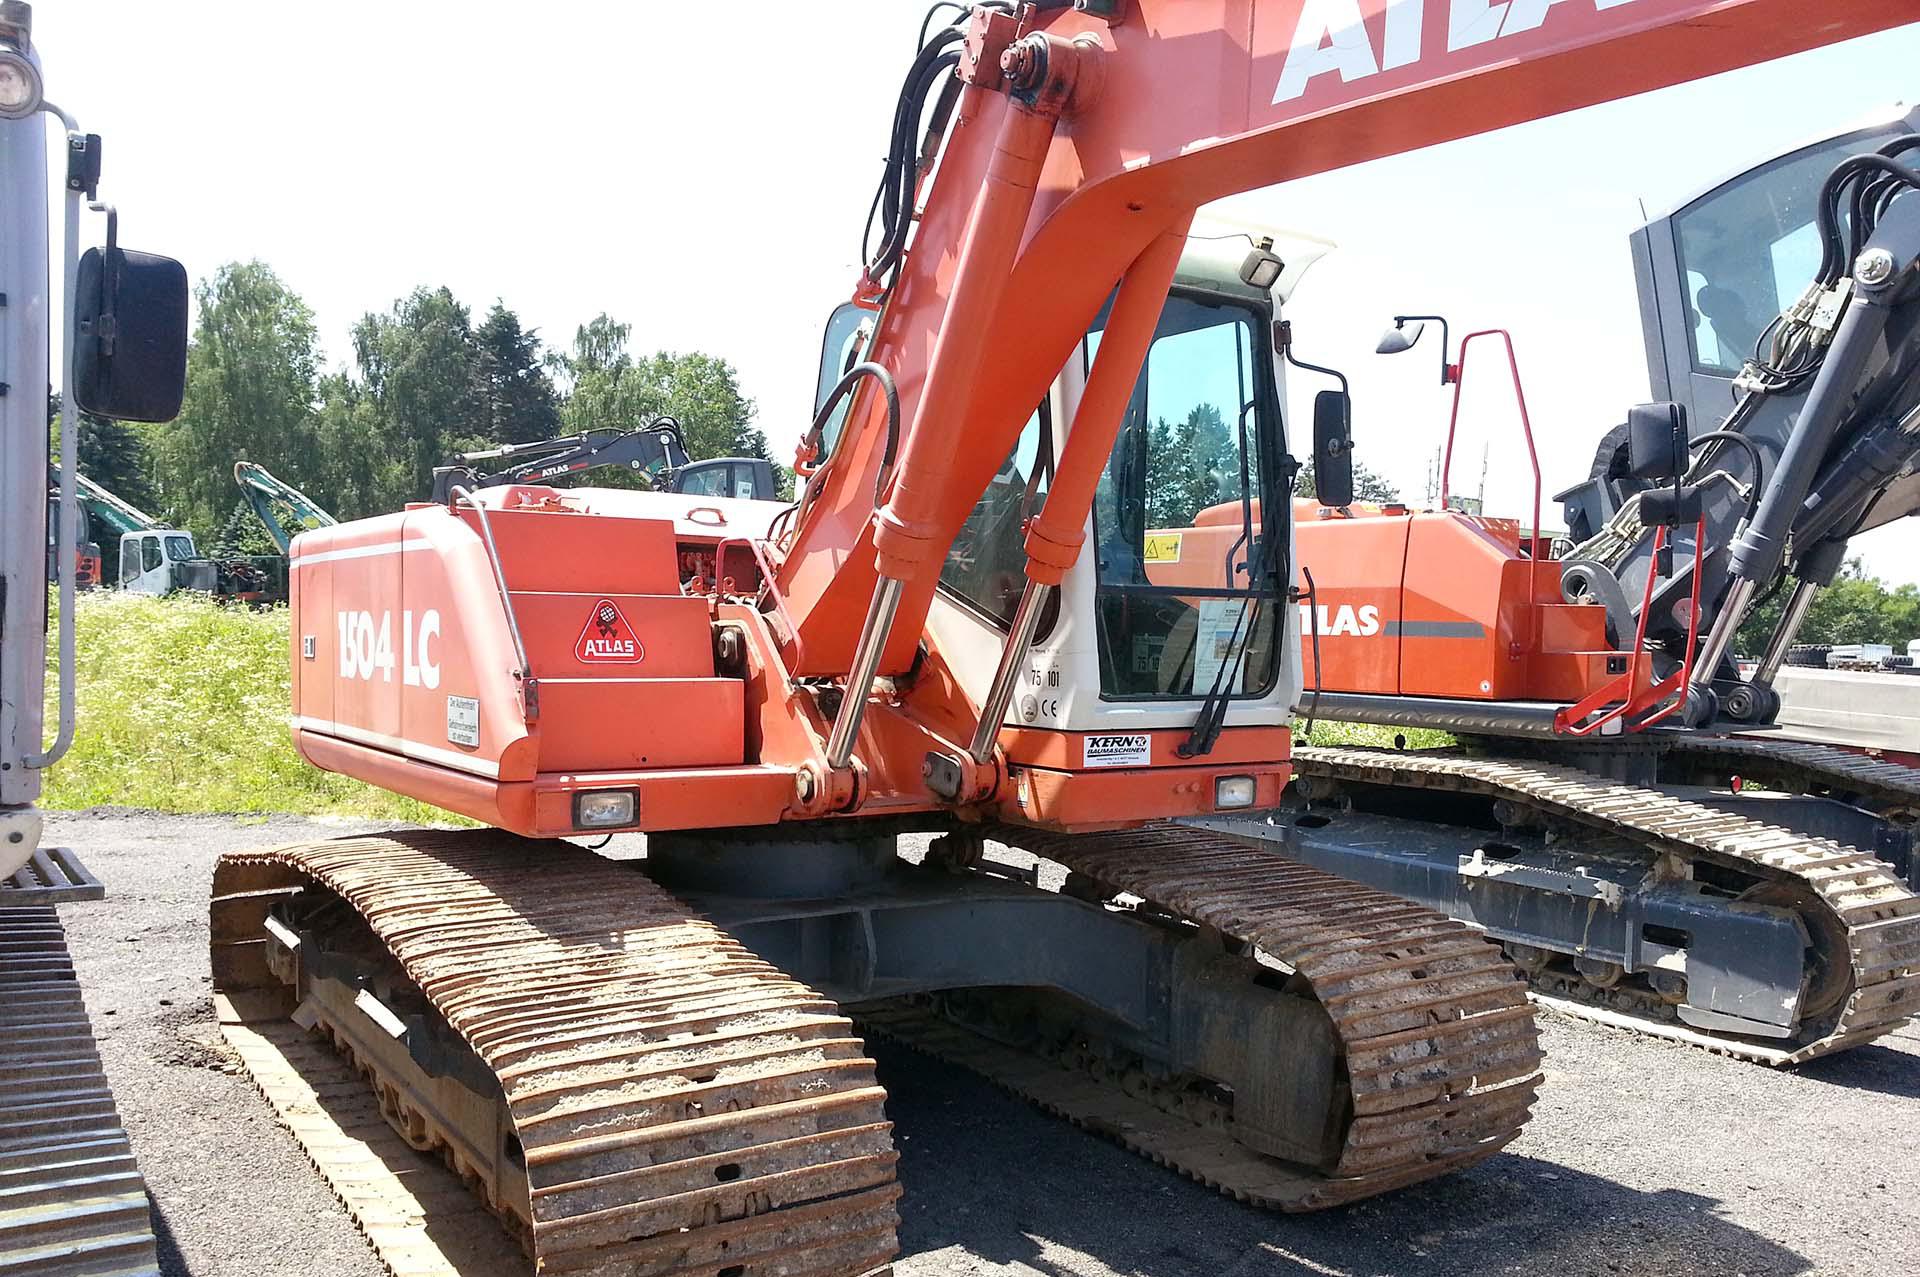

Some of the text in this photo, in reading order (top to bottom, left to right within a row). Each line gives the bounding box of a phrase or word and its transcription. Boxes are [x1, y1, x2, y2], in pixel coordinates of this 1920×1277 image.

[542, 464, 569, 477] ATLAS
[1299, 604, 1379, 636] TLAS
[338, 609, 440, 690] 1504 LC
[584, 639, 635, 656] ATLAS
[1031, 670, 1060, 687] 75 101
[1088, 736, 1135, 748] KERN
